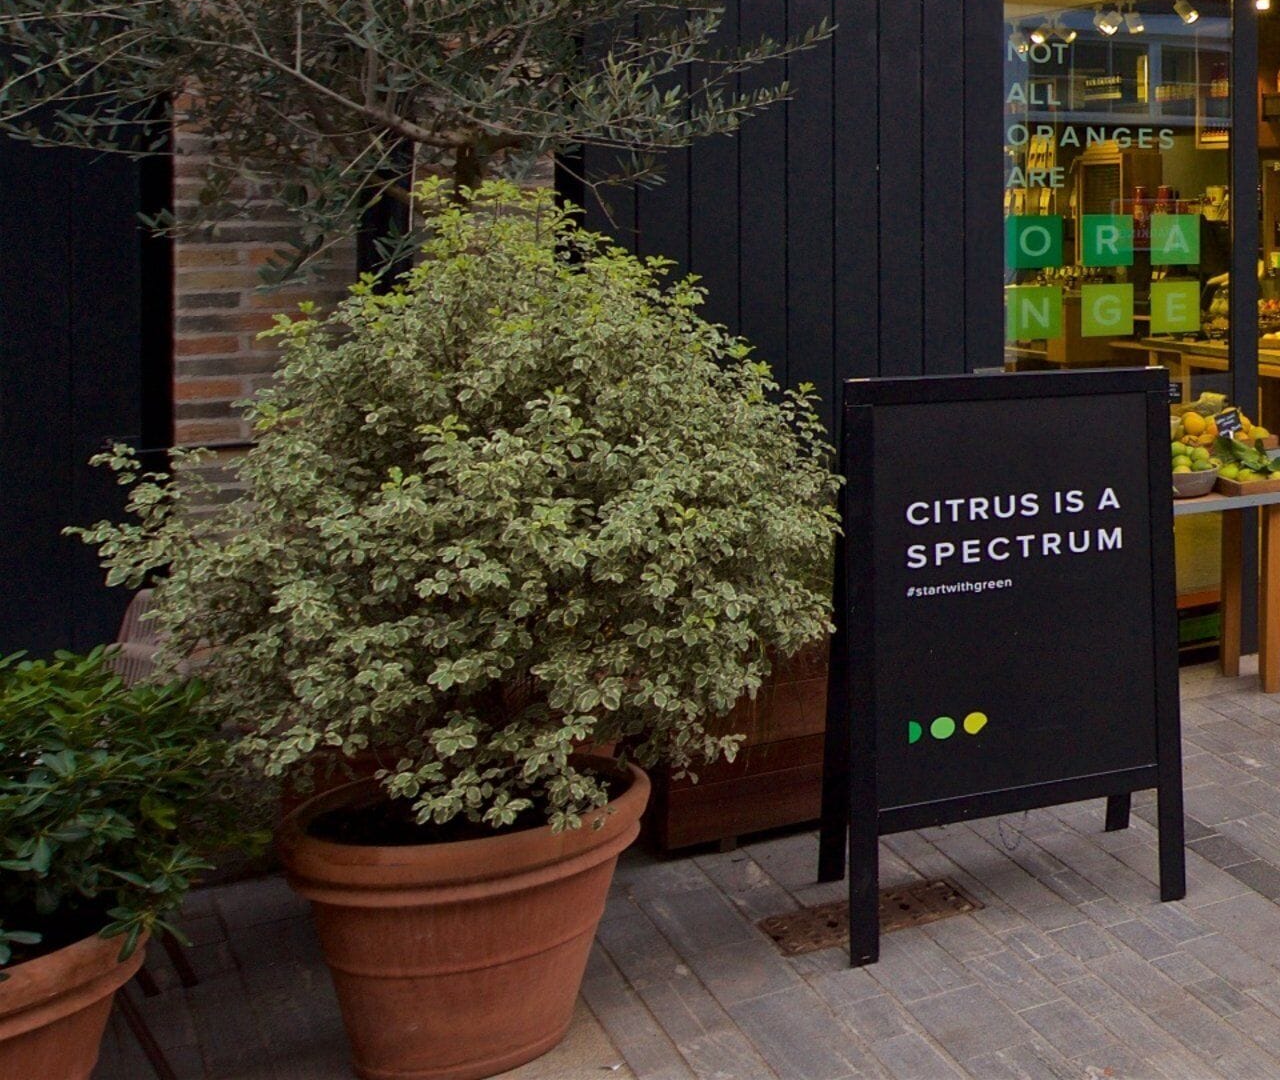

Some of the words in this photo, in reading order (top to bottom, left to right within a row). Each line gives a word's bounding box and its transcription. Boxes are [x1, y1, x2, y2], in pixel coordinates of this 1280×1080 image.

[1007, 42, 1068, 65] NOT
[1006, 82, 1061, 106] ALL
[1007, 124, 1175, 150] ORANGES
[1006, 166, 1065, 188] ARE
[906, 493, 1040, 525] CITRUS
[1055, 490, 1085, 514] IS
[1097, 487, 1121, 510] A
[907, 527, 1122, 569] SPECTRUM
[906, 578, 1013, 598] #startwithgreen
